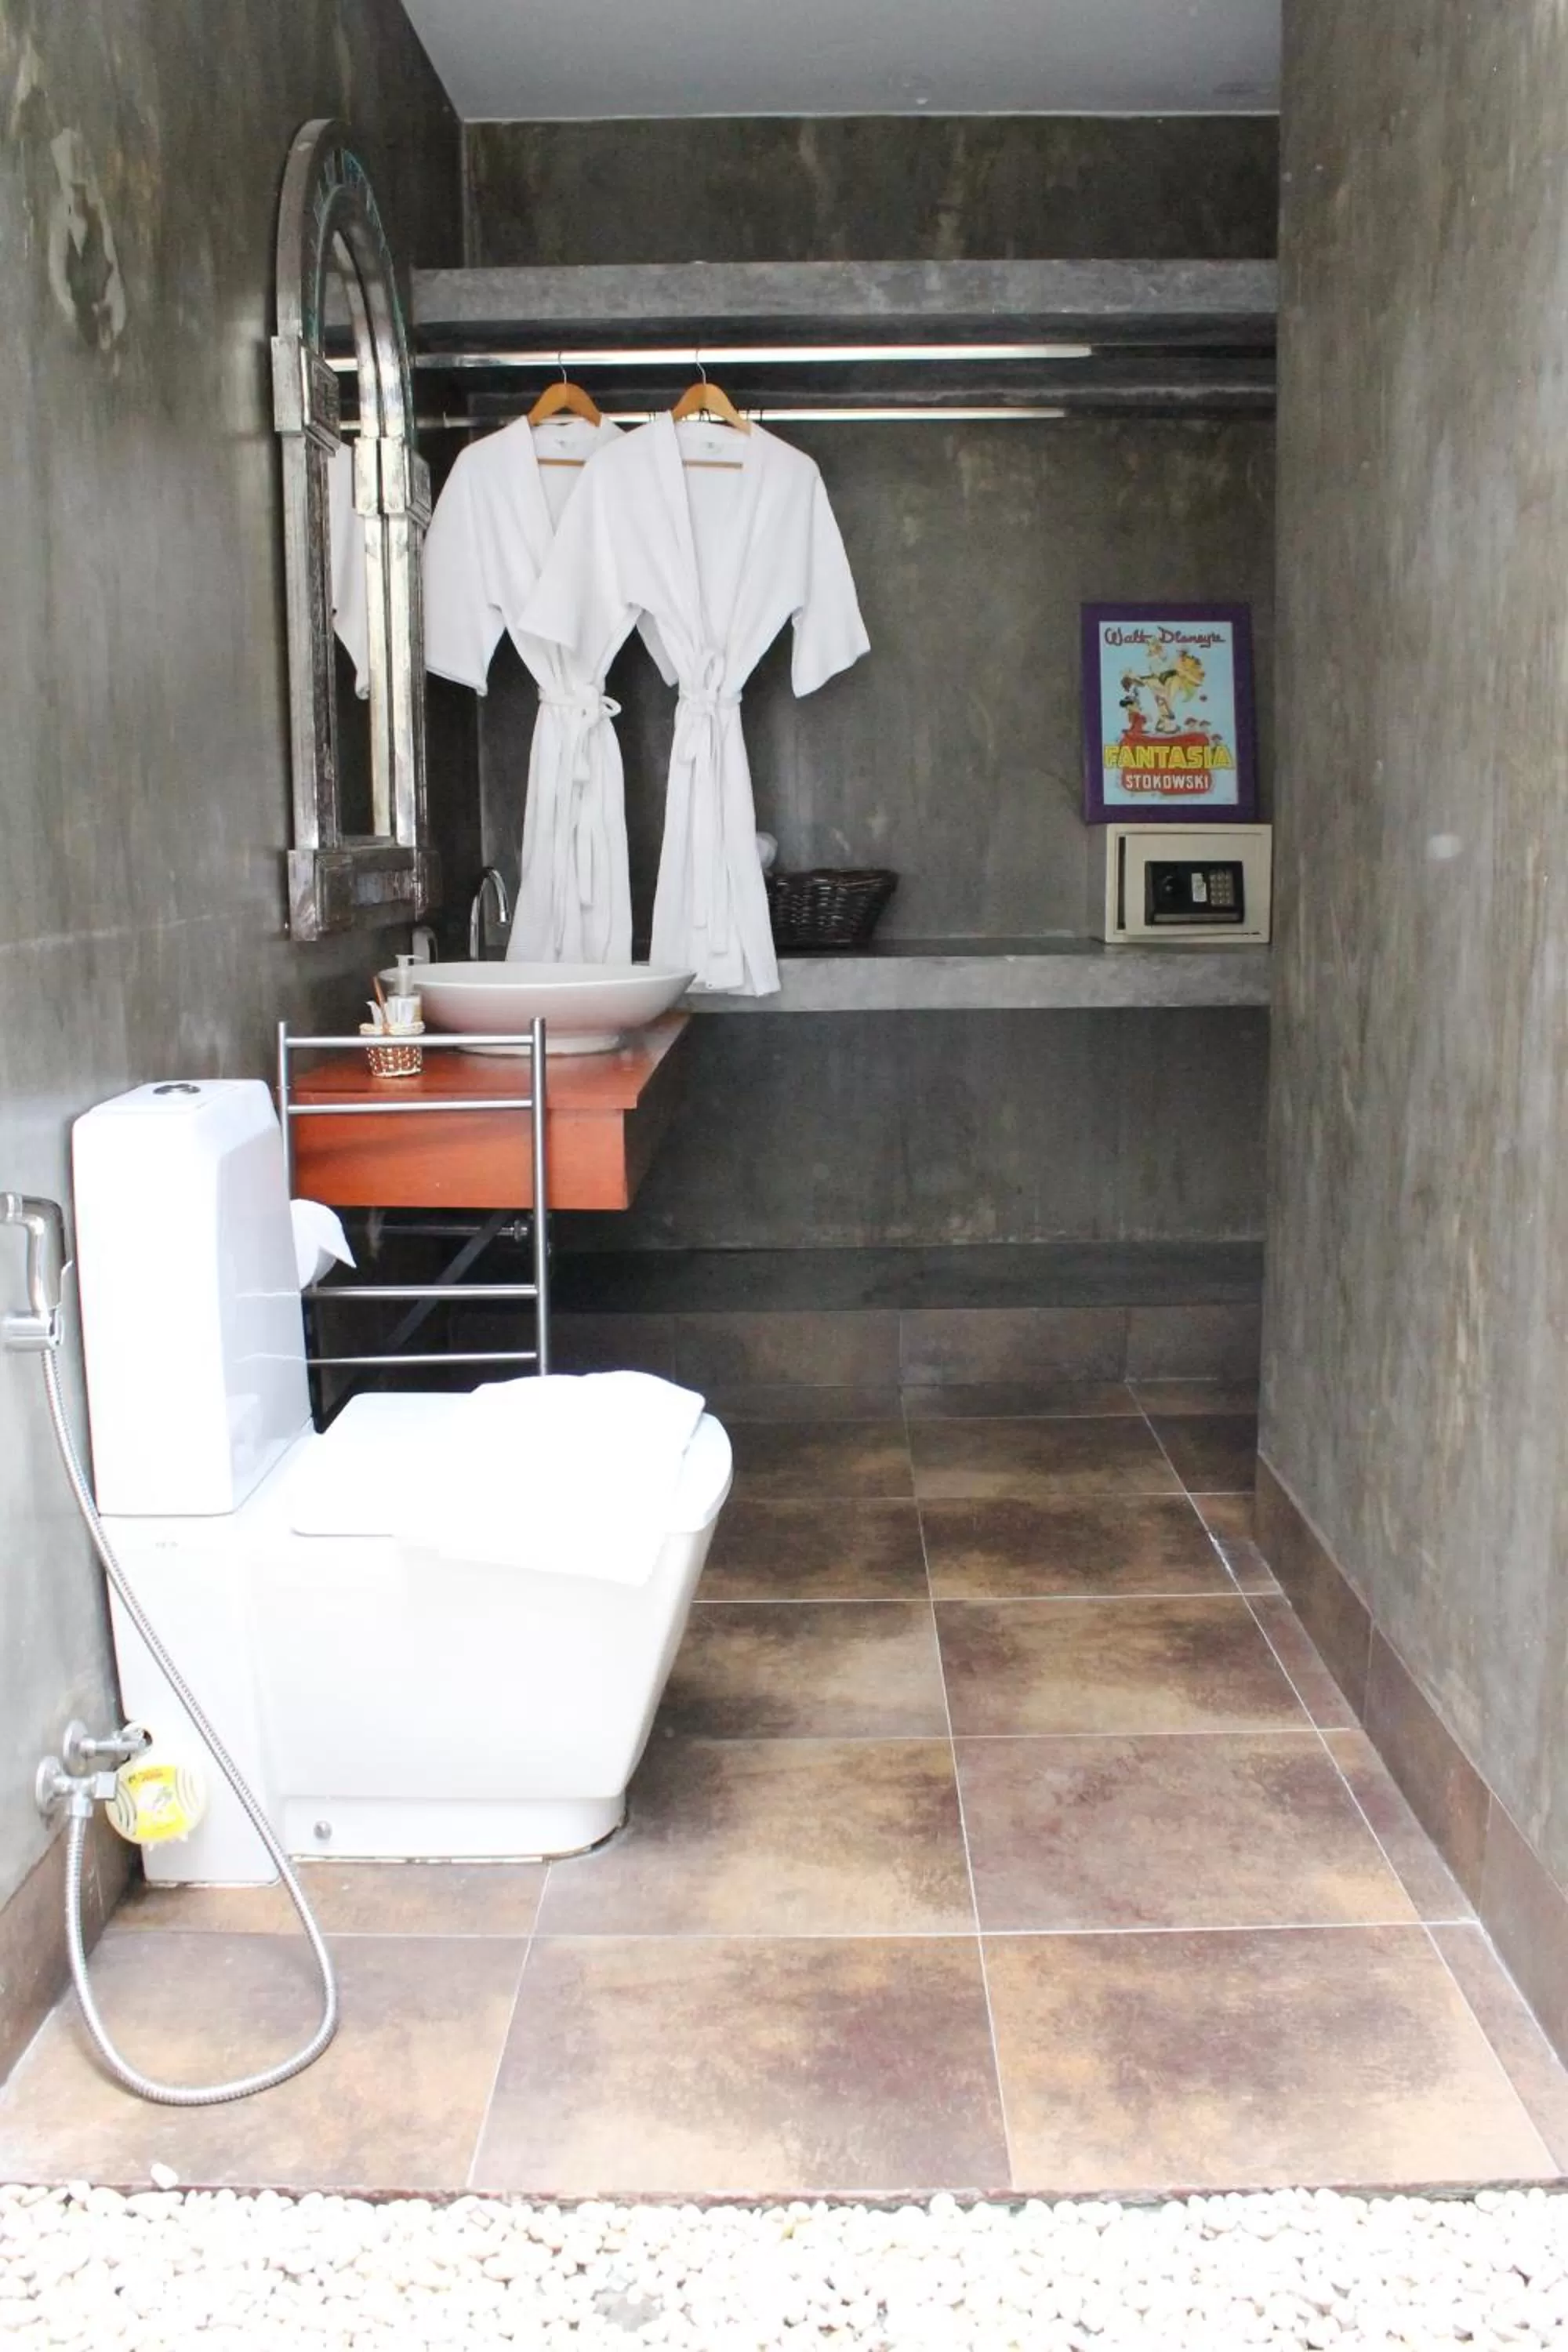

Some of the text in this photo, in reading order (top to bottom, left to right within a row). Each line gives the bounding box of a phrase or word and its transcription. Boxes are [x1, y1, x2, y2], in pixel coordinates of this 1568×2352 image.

[1104, 627, 1152, 646] Walt
[1104, 746, 1233, 769] FANTASIA
[1126, 774, 1209, 789] STOKOWSKI
